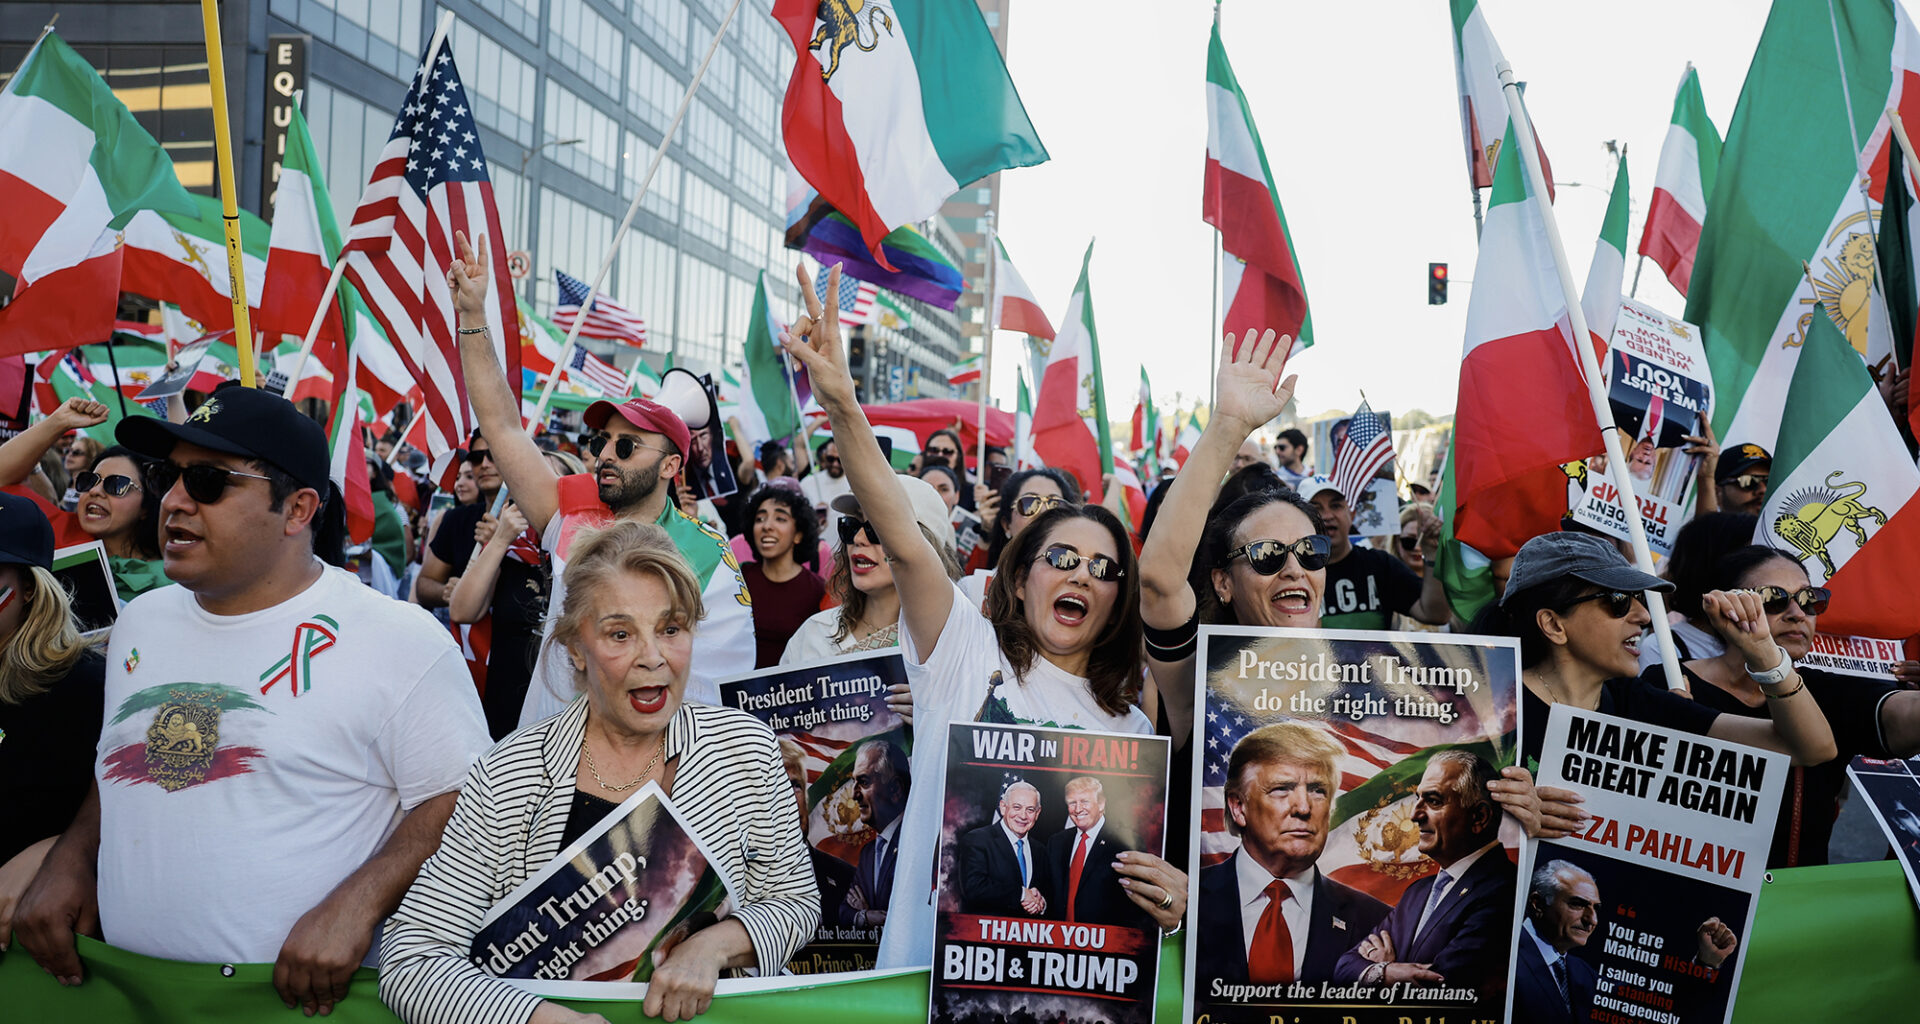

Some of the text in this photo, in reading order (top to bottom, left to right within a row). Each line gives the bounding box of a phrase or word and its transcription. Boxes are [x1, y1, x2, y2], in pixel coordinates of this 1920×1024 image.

[1618, 329, 1694, 364] YOUR HELP
[1637, 327, 1671, 346] NOW
[1626, 340, 1690, 372] WE NEED
[1621, 372, 1700, 412] WE TRUST
[1637, 363, 1685, 394] YOU
[1578, 508, 1586, 516] TO
[1587, 498, 1666, 538] PREDENT
[1587, 512, 1602, 524] IRAN
[1603, 518, 1612, 527] OF
[1833, 657, 1866, 672] REGIME
[1868, 660, 1878, 673] OF
[1876, 640, 1898, 662] BY
[1238, 649, 1479, 696] President Trump,
[736, 675, 887, 710] President Trump,
[1254, 688, 1458, 724] do the right thing.
[769, 702, 874, 731] the right thing.
[972, 728, 1139, 770] WAR IN IRAN!
[1566, 716, 1768, 792] MAKE IRAN
[1560, 752, 1758, 824] GREAT AGAIN
[1624, 824, 1746, 879] PAHLAVI
[474, 851, 647, 978] ident Trump,
[534, 895, 648, 980] right thing.
[818, 926, 834, 940] the
[836, 926, 866, 940] leader
[868, 926, 878, 944] of
[978, 918, 1106, 950] THANK YOU
[1608, 921, 1664, 950] You are
[812, 953, 853, 974] Prince
[944, 946, 1139, 994] BIBI & TRUMP
[1603, 938, 1720, 984] Making History
[1210, 978, 1478, 1004] Support the leader of Iranians,
[1596, 978, 1674, 1010] for standing
[1598, 963, 1674, 994] I salute you
[1593, 994, 1680, 1024] courageously
